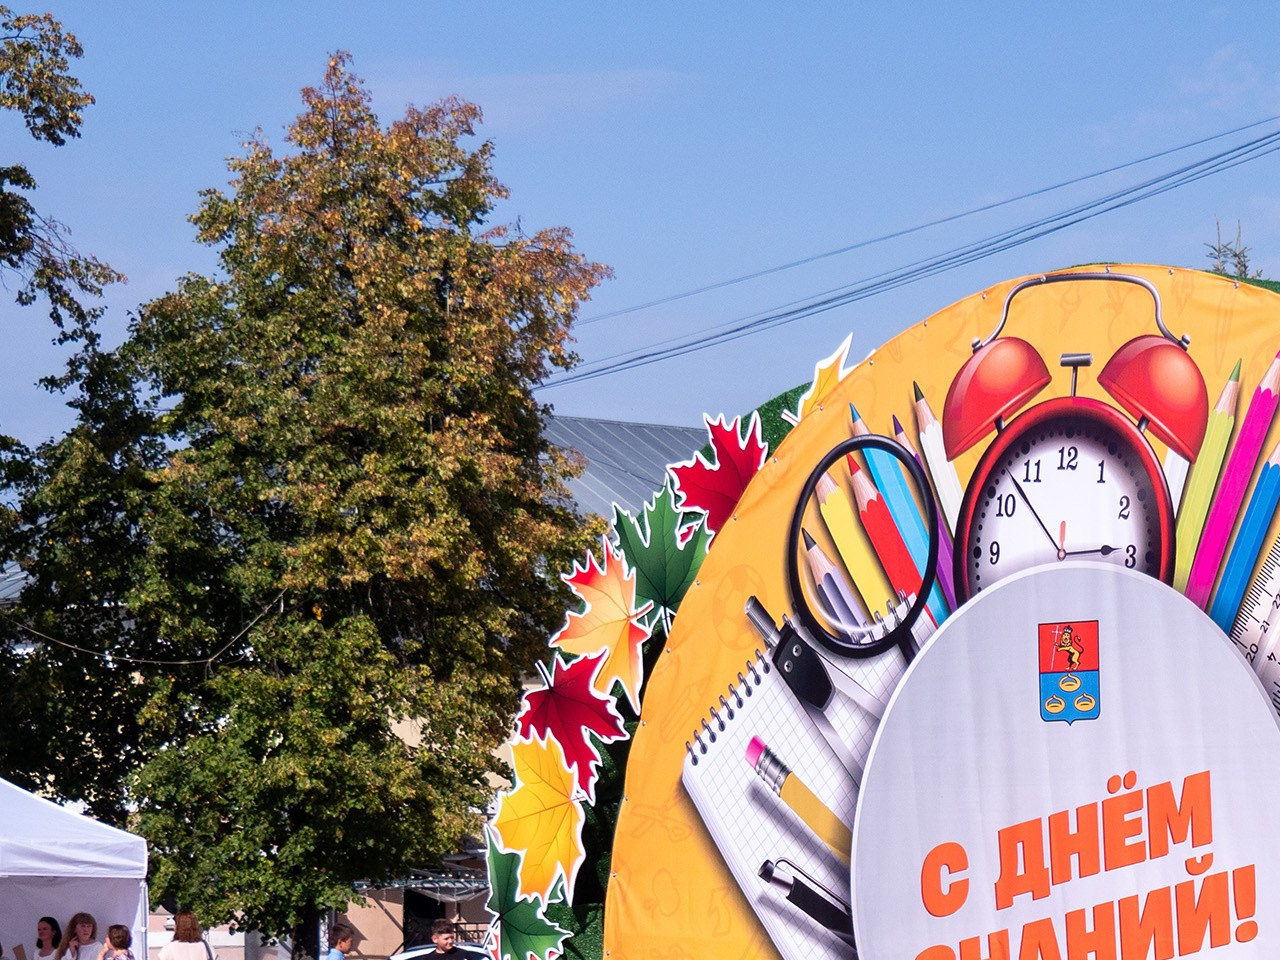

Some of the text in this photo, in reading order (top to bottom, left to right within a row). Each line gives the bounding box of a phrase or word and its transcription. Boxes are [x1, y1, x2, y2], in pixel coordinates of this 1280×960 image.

[1057, 446, 1079, 471] 12
[1022, 459, 1042, 483] 11
[1096, 460, 1106, 483] 1
[995, 494, 1016, 518] 10
[1118, 495, 1130, 520] 2
[989, 541, 1000, 565] 9
[1124, 544, 1137, 568] 3
[1245, 643, 1259, 663] 20
[1260, 620, 1270, 633] 21
[1267, 652, 1277, 662] 4
[921, 770, 1213, 918] С ДНЁМ
